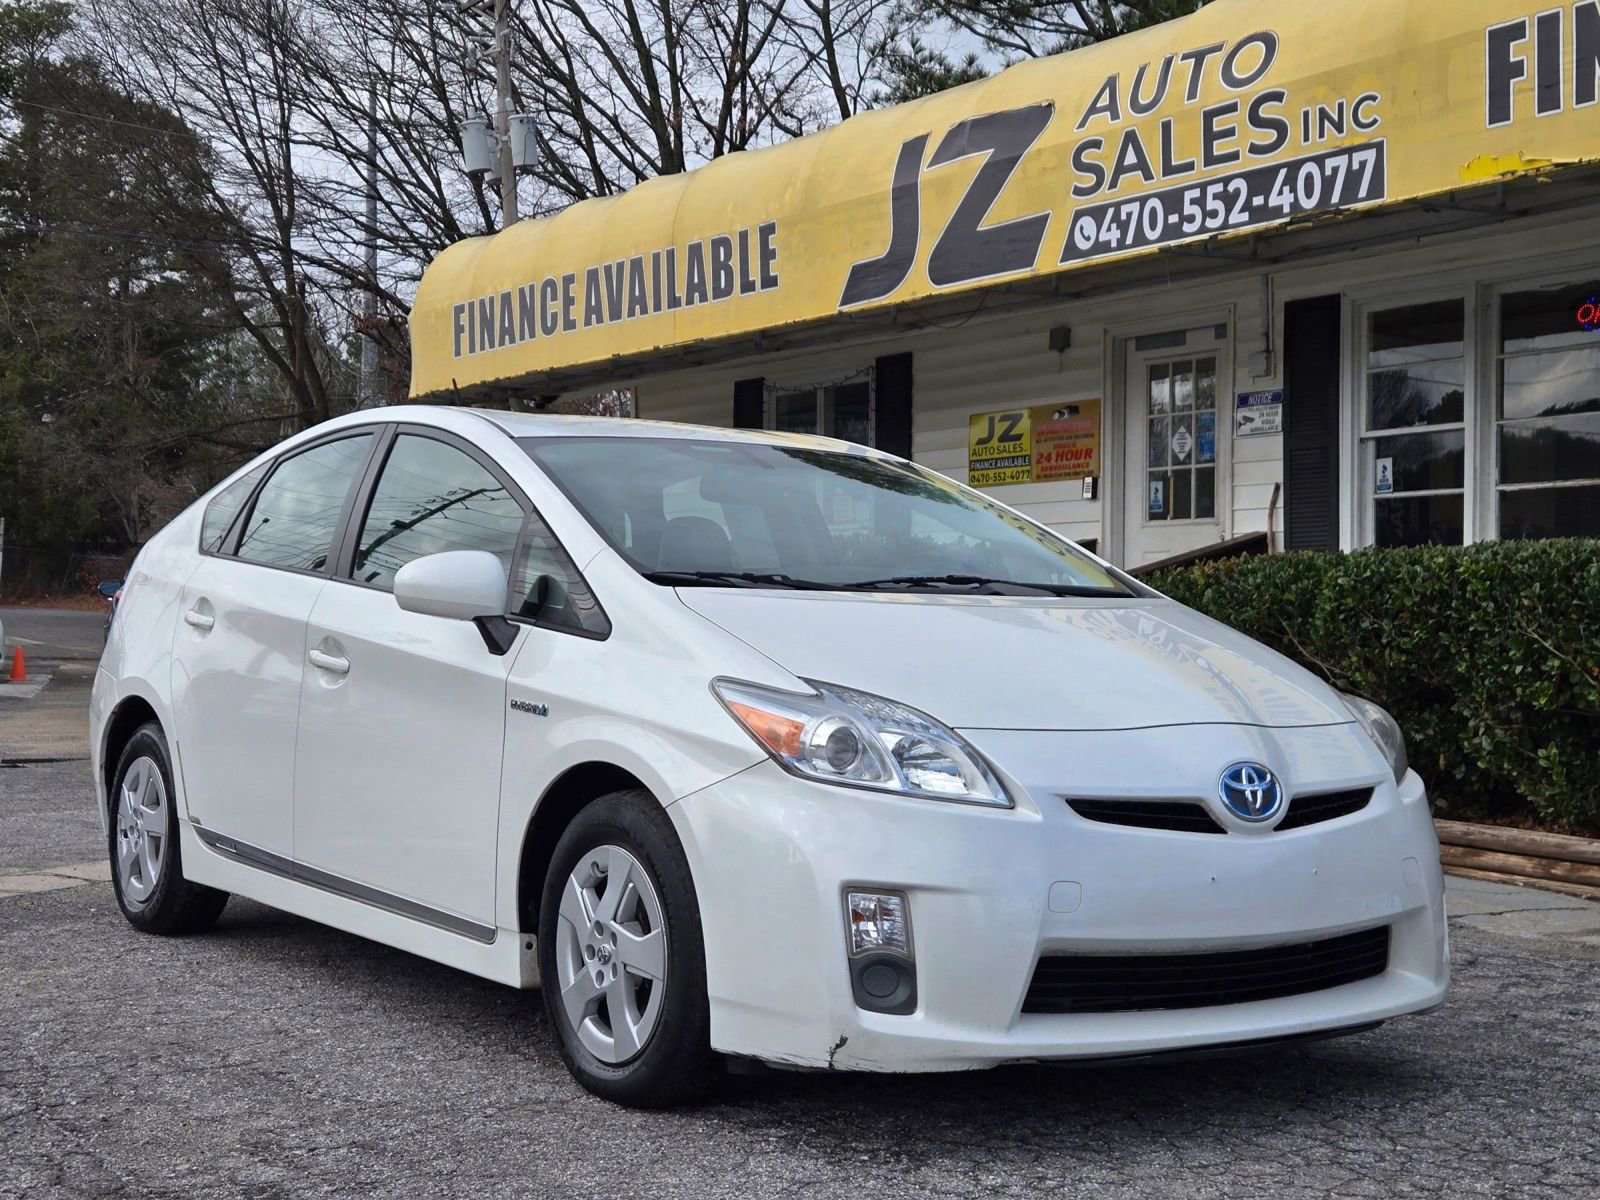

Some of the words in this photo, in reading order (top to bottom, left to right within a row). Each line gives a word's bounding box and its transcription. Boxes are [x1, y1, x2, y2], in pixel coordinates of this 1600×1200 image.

[1074, 30, 1279, 132] AUTO
[1071, 88, 1290, 200] SALES
[1301, 91, 1382, 146] INC
[836, 99, 1055, 311] JZ
[1098, 147, 1377, 248] 470-552-4077
[453, 271, 577, 359] FINANCE
[583, 220, 779, 328] AVAILABLE
[975, 412, 1025, 446] JZ
[1248, 391, 1273, 405] NOTICE
[971, 446, 995, 457] AUTO
[996, 443, 1024, 454] SALES
[971, 459, 996, 471] FINANCE
[996, 456, 1030, 468] AVAILABLE
[1036, 451, 1052, 465] 24
[1055, 447, 1093, 462] HOUR
